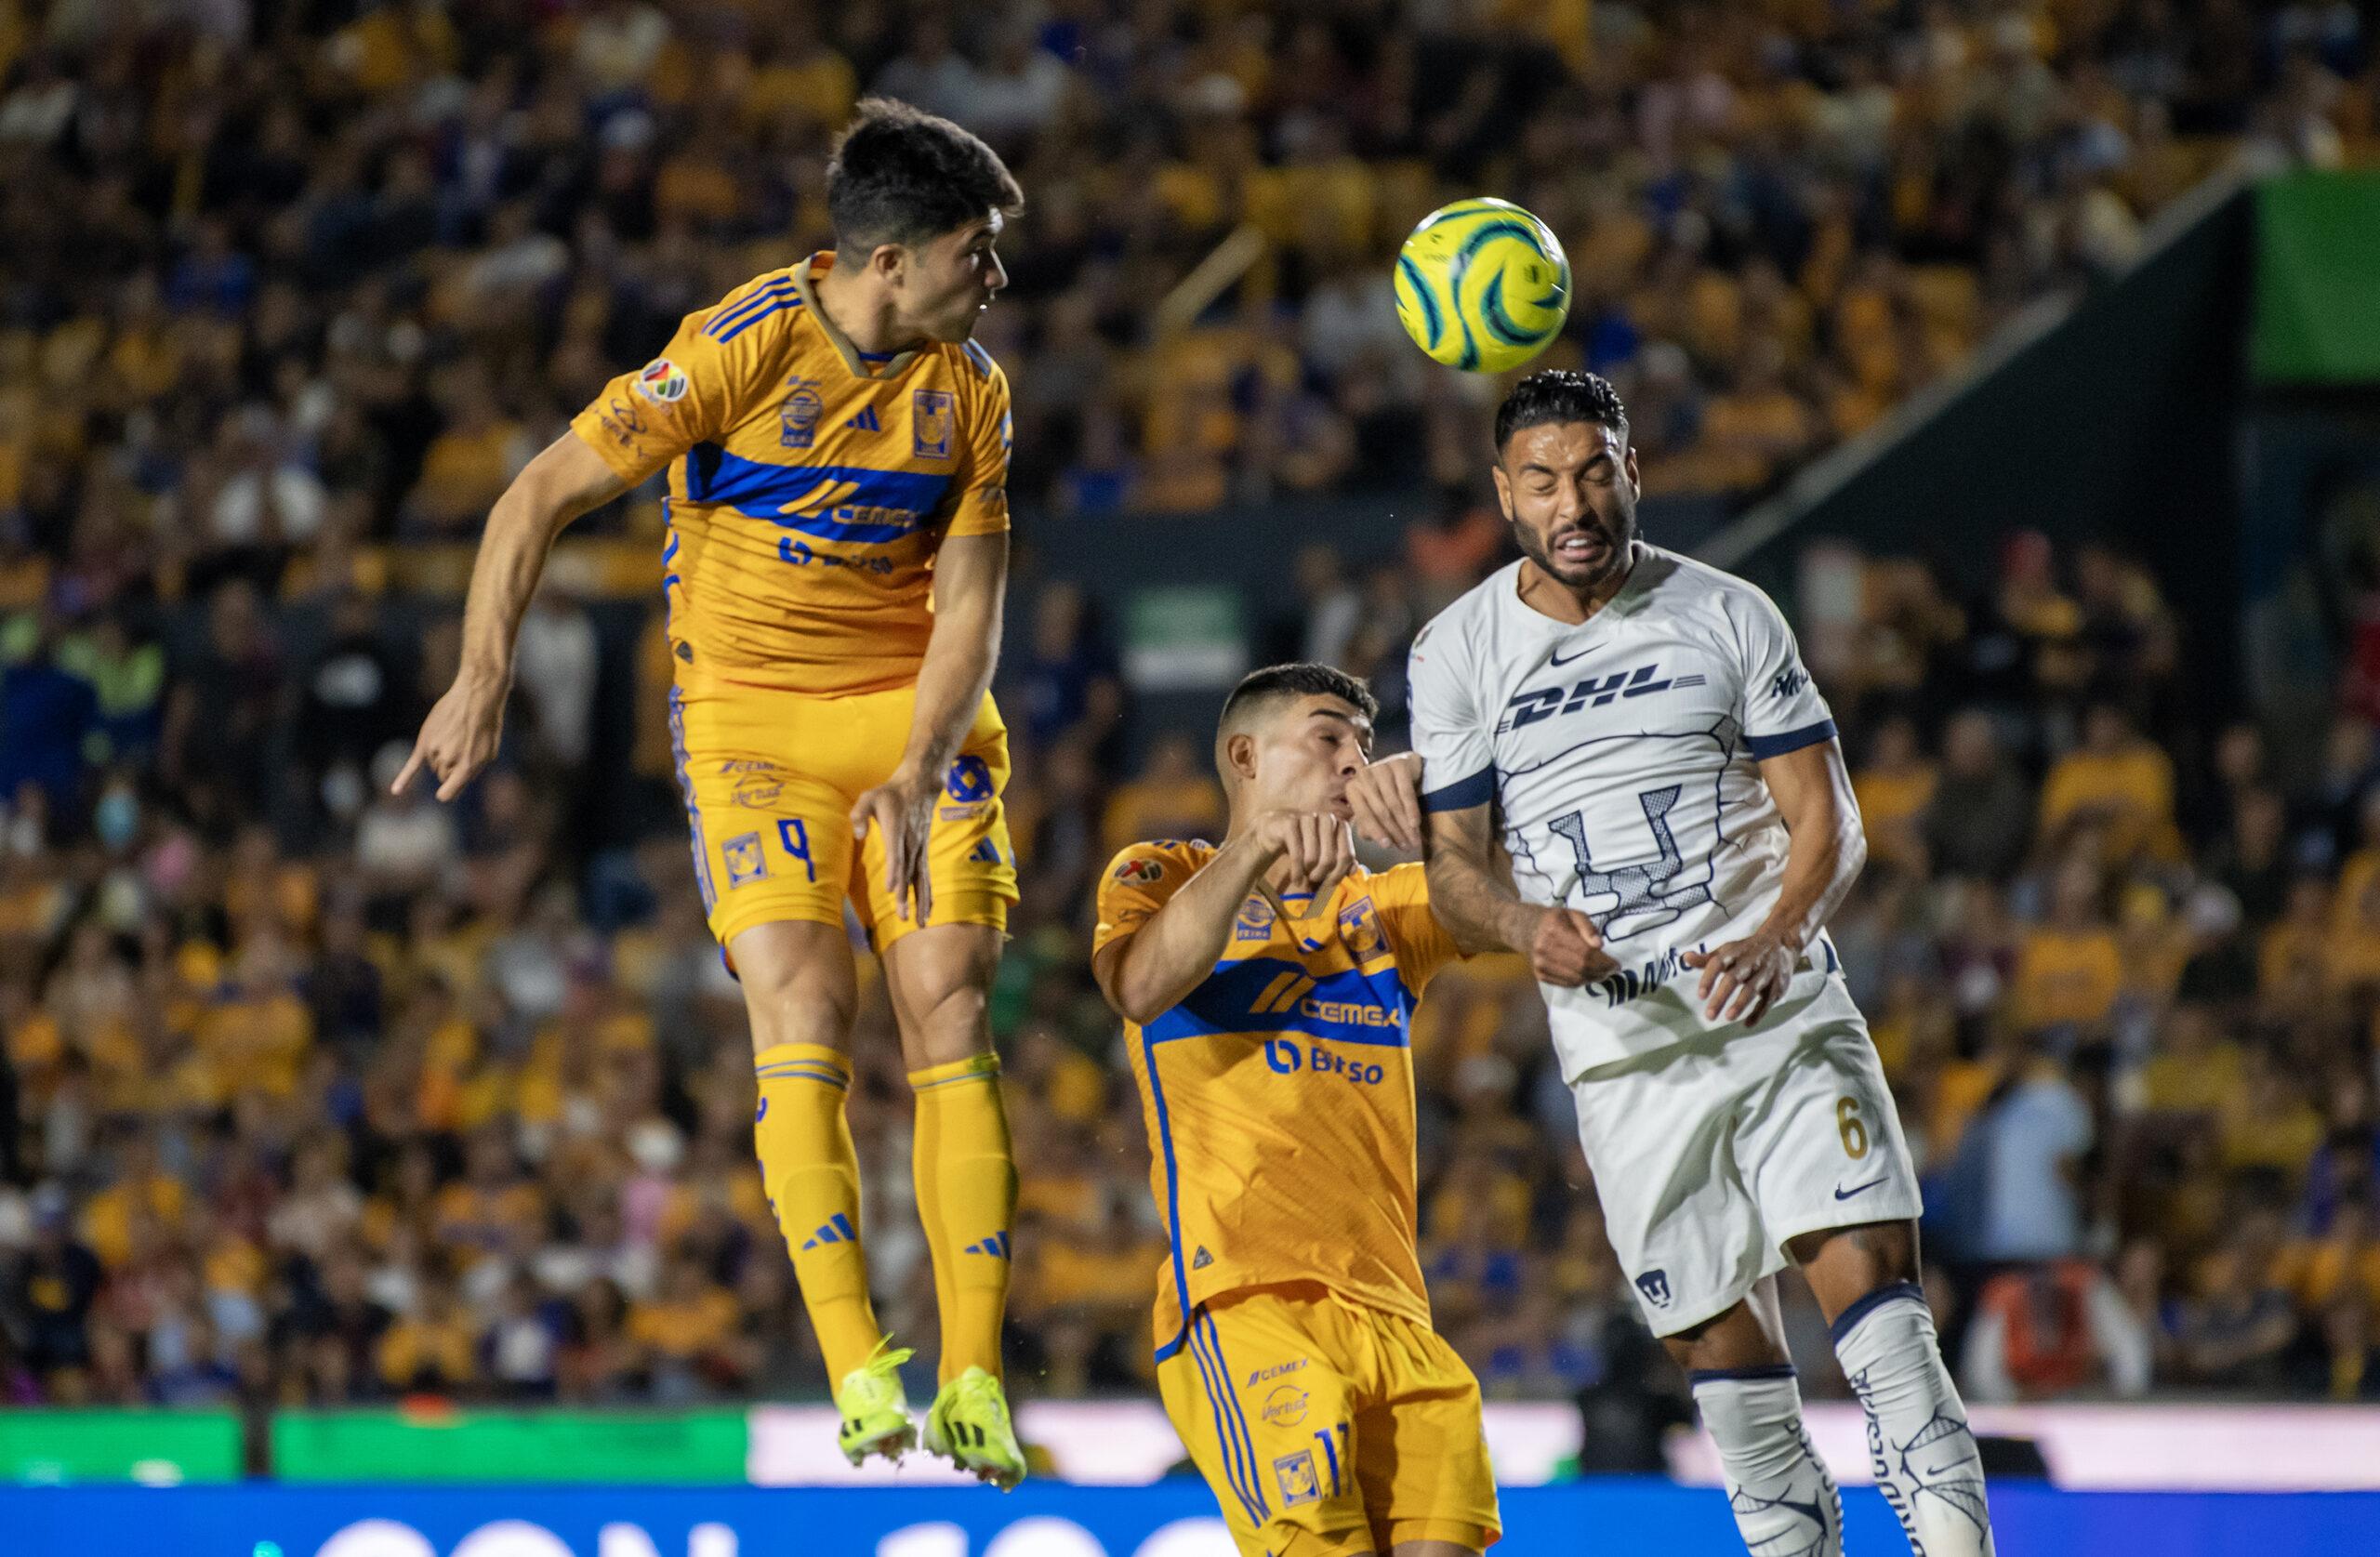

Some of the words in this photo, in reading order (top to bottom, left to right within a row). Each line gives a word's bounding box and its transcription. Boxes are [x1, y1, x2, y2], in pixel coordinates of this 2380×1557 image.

[832, 505, 916, 528] CEME
[1508, 664, 1673, 731] DHL
[777, 819, 816, 883] 9
[1301, 998, 1402, 1027] CEMEX
[1311, 1047, 1383, 1085] Btso
[1837, 1097, 1869, 1160] 6
[1261, 1358, 1308, 1381] CEMEX
